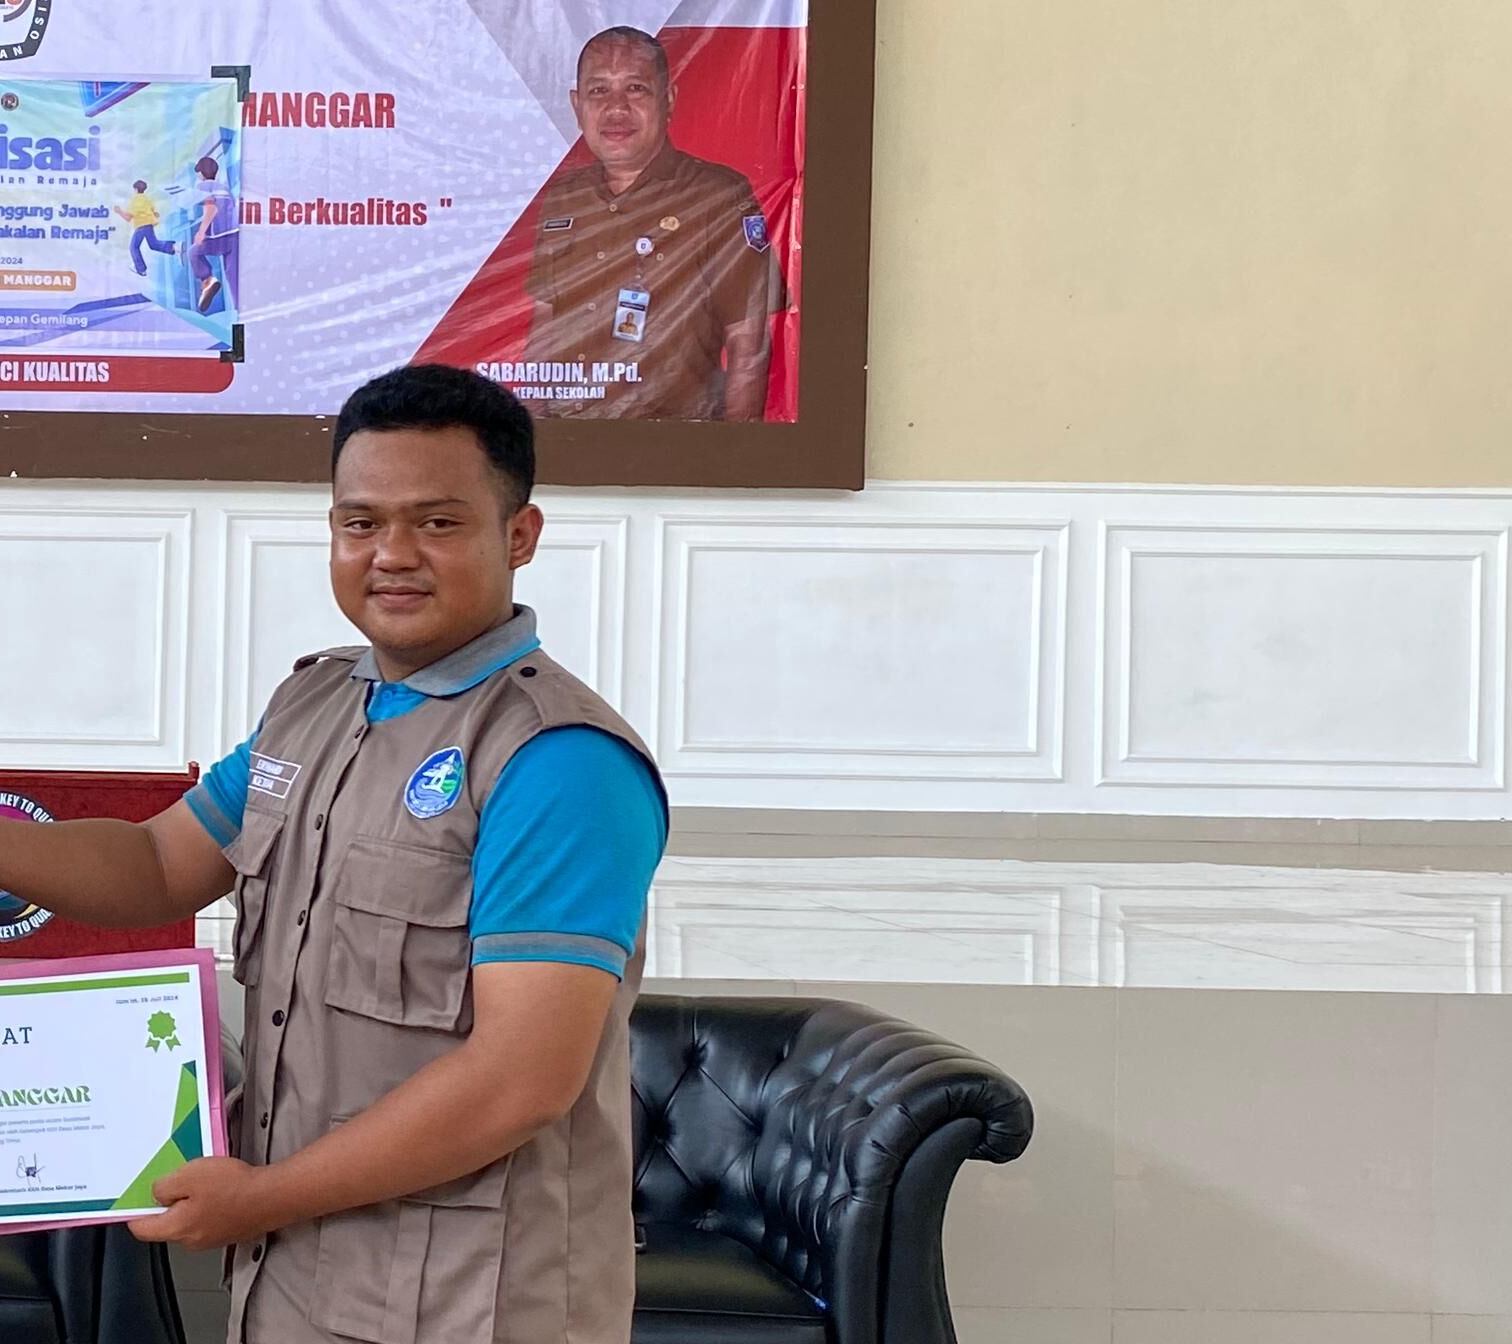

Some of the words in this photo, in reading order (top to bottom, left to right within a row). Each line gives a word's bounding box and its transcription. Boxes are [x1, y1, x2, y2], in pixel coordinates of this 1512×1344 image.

[37, 175, 97, 187] Remaja
[58, 203, 109, 218] Jawab
[269, 197, 427, 226] Berkualitas
[0, 256, 23, 265] 2024
[3, 274, 72, 287] MANGGAR
[30, 313, 89, 327] Gemilang
[23, 361, 110, 383] KUALITAS
[476, 362, 588, 385] SABARUDIN,
[592, 362, 643, 382] M.Pd.
[555, 387, 606, 400] SEKOLAH
[0, 792, 20, 808] KEY
[20, 798, 35, 814] TO
[15, 920, 31, 935] TO
